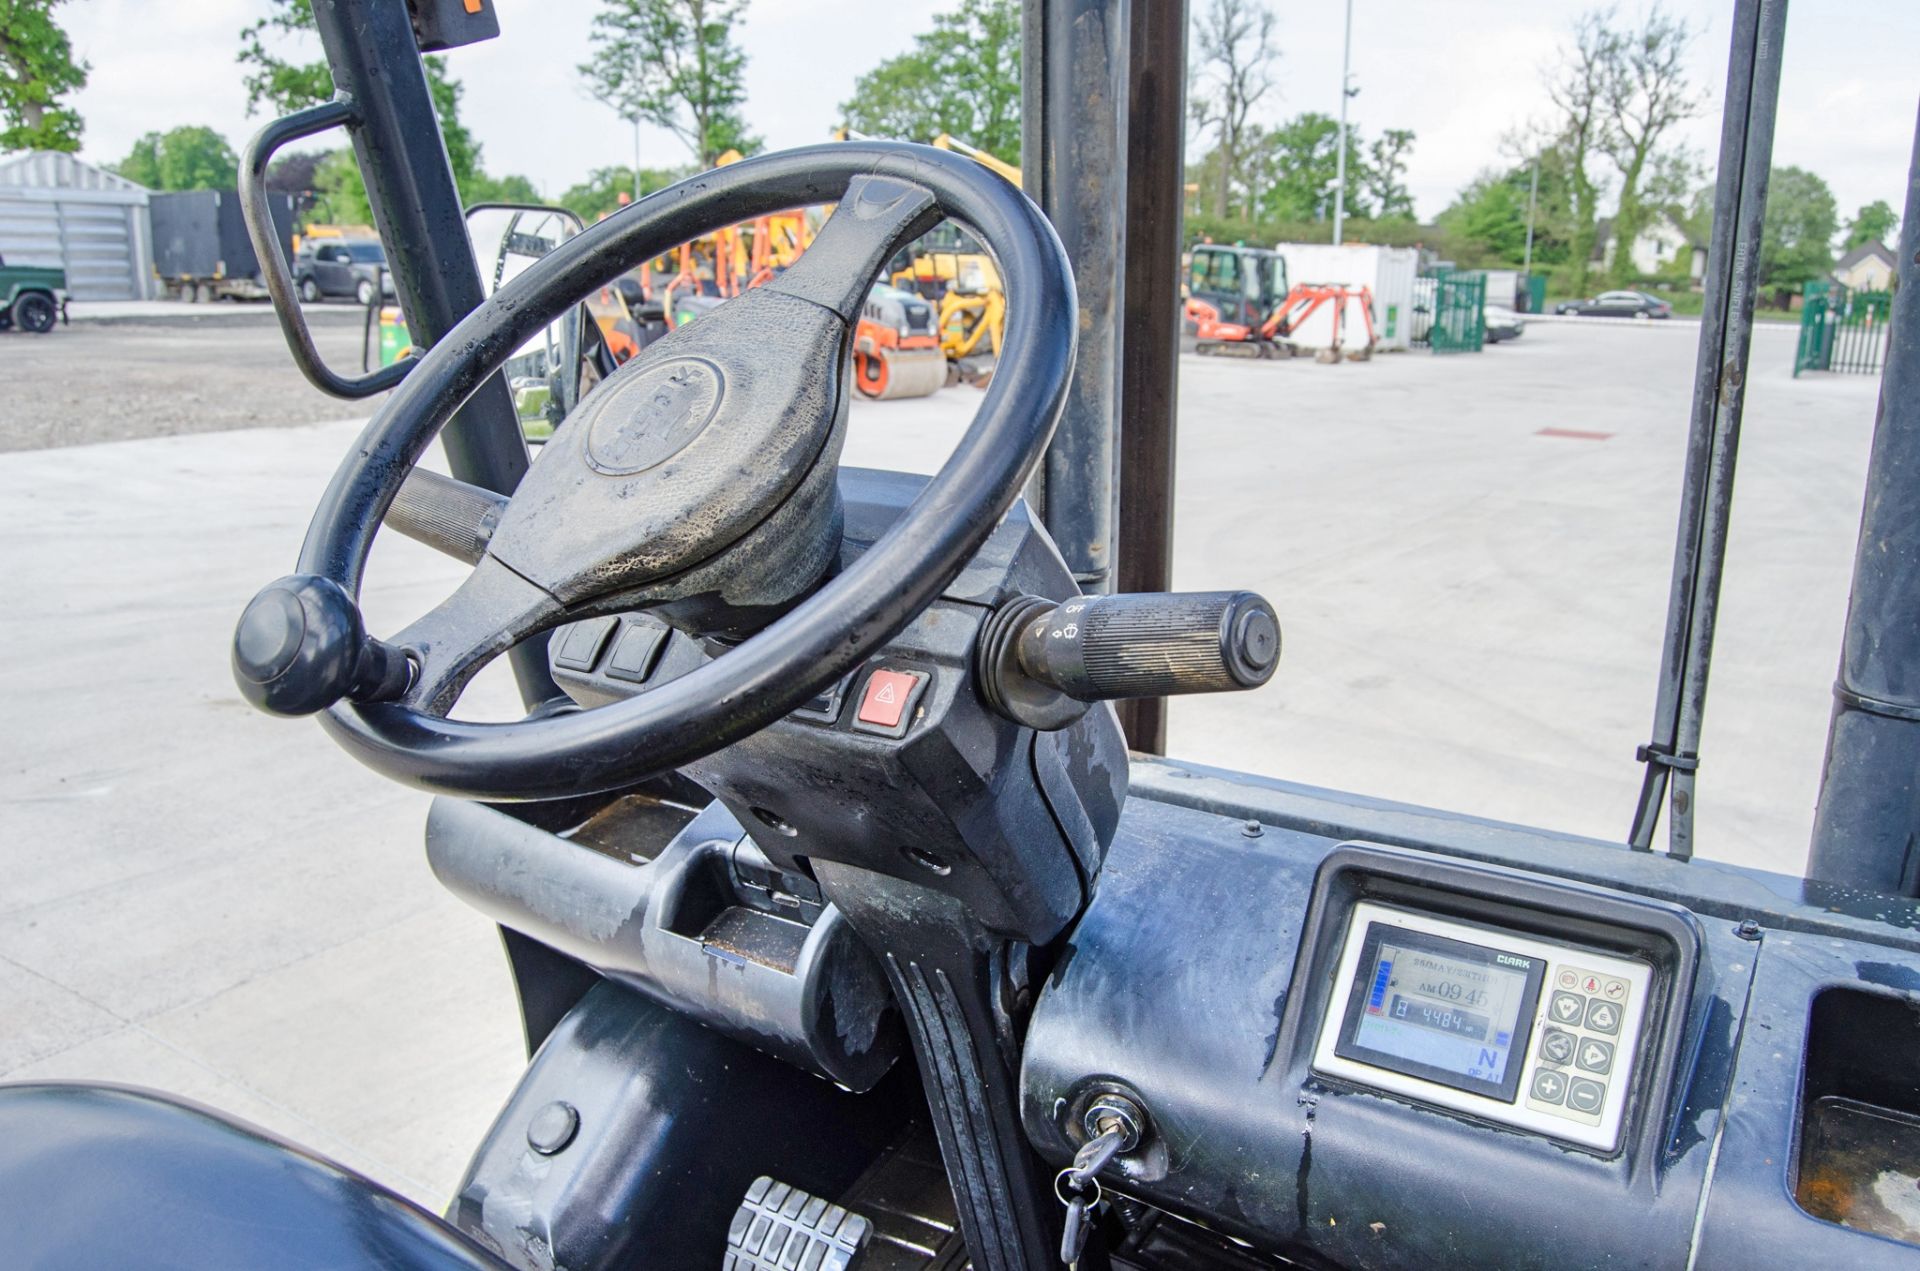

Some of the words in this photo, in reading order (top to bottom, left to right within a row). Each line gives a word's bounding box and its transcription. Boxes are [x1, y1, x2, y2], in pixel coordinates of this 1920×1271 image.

[1735, 240, 1748, 275] EATON
[1729, 279, 1743, 325] SYNFLEX
[1065, 603, 1087, 614] OFF
[1496, 954, 1531, 969] CLARK
[1418, 982, 1436, 994] AM
[1423, 1007, 1462, 1030] 4484
[1477, 1047, 1498, 1069] N
